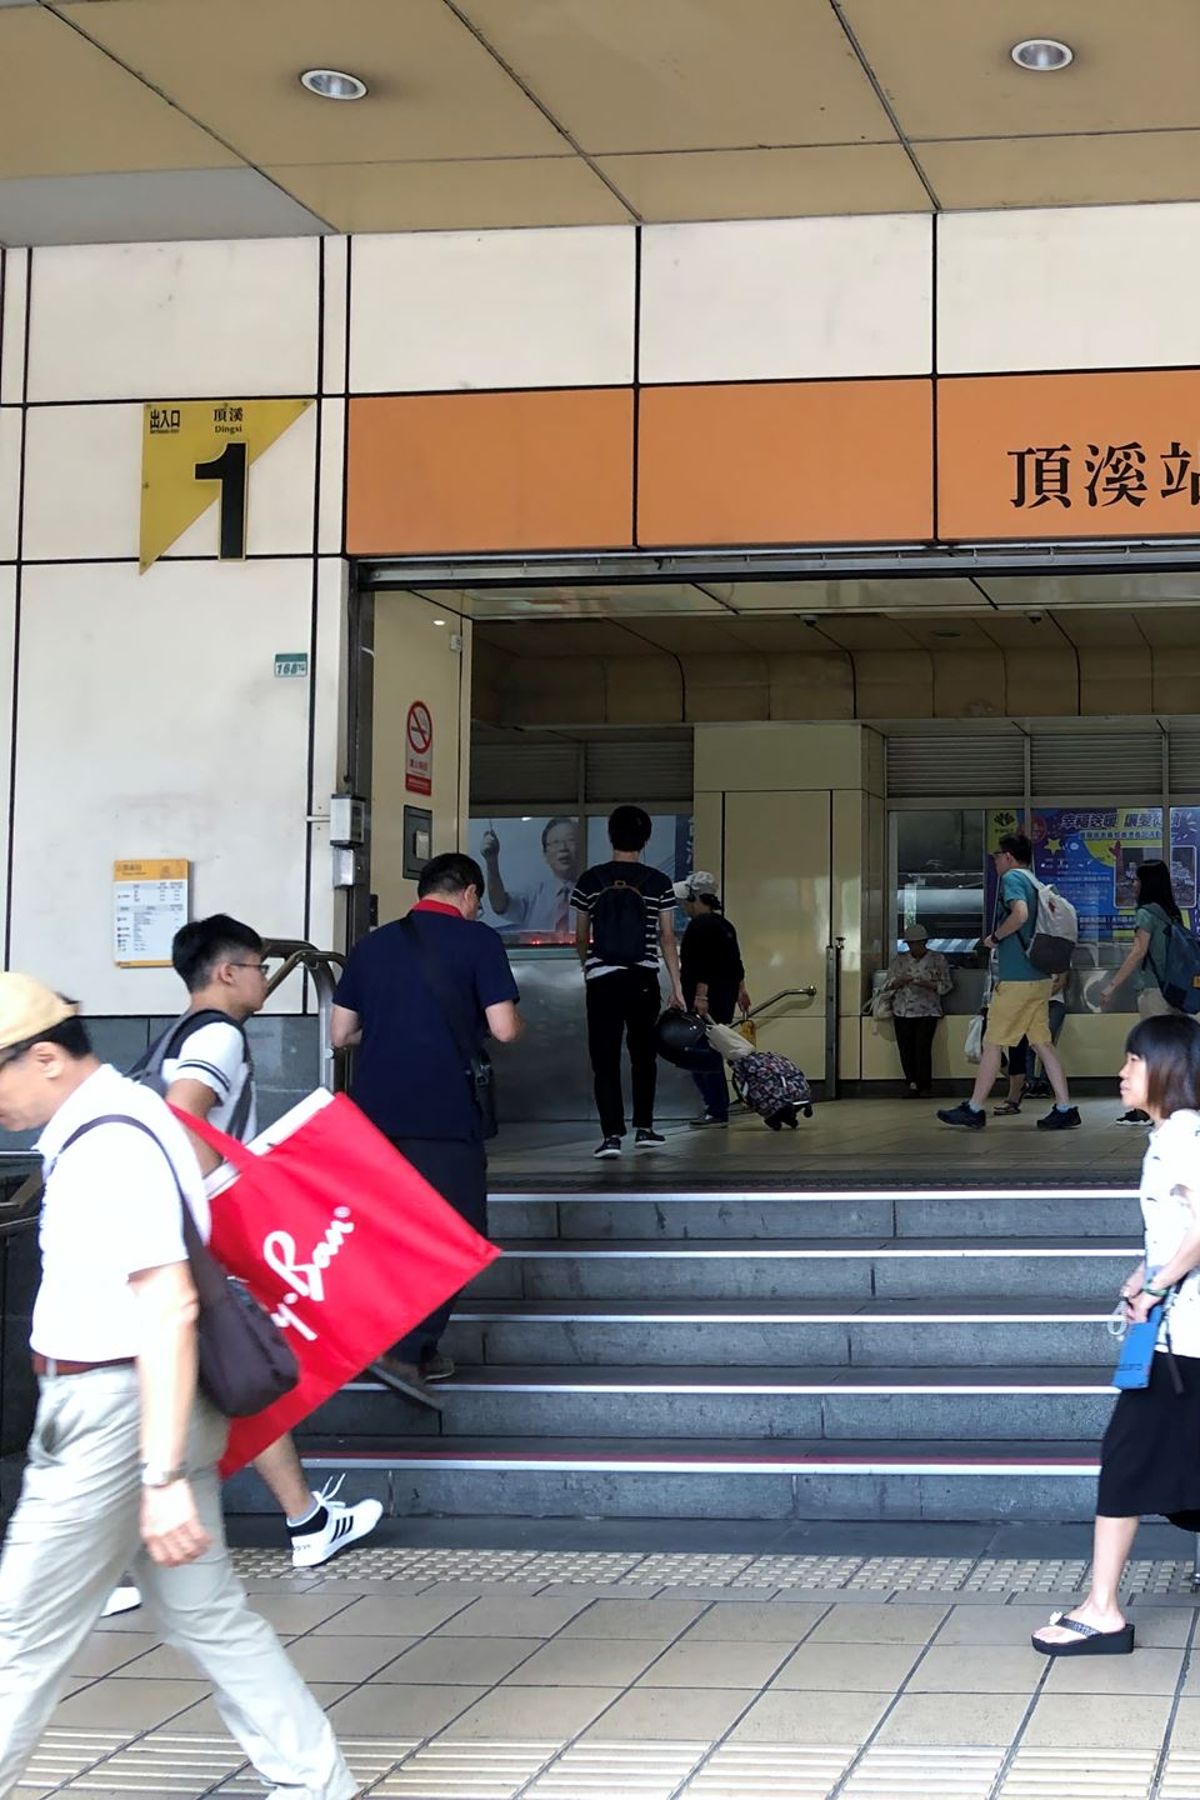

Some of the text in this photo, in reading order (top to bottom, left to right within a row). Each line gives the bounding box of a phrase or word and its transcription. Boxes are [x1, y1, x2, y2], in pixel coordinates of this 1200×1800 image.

[149, 409, 180, 429] 出入口
[213, 406, 243, 422] 頂溪
[214, 424, 243, 434] Dingxi
[194, 442, 247, 560] 1
